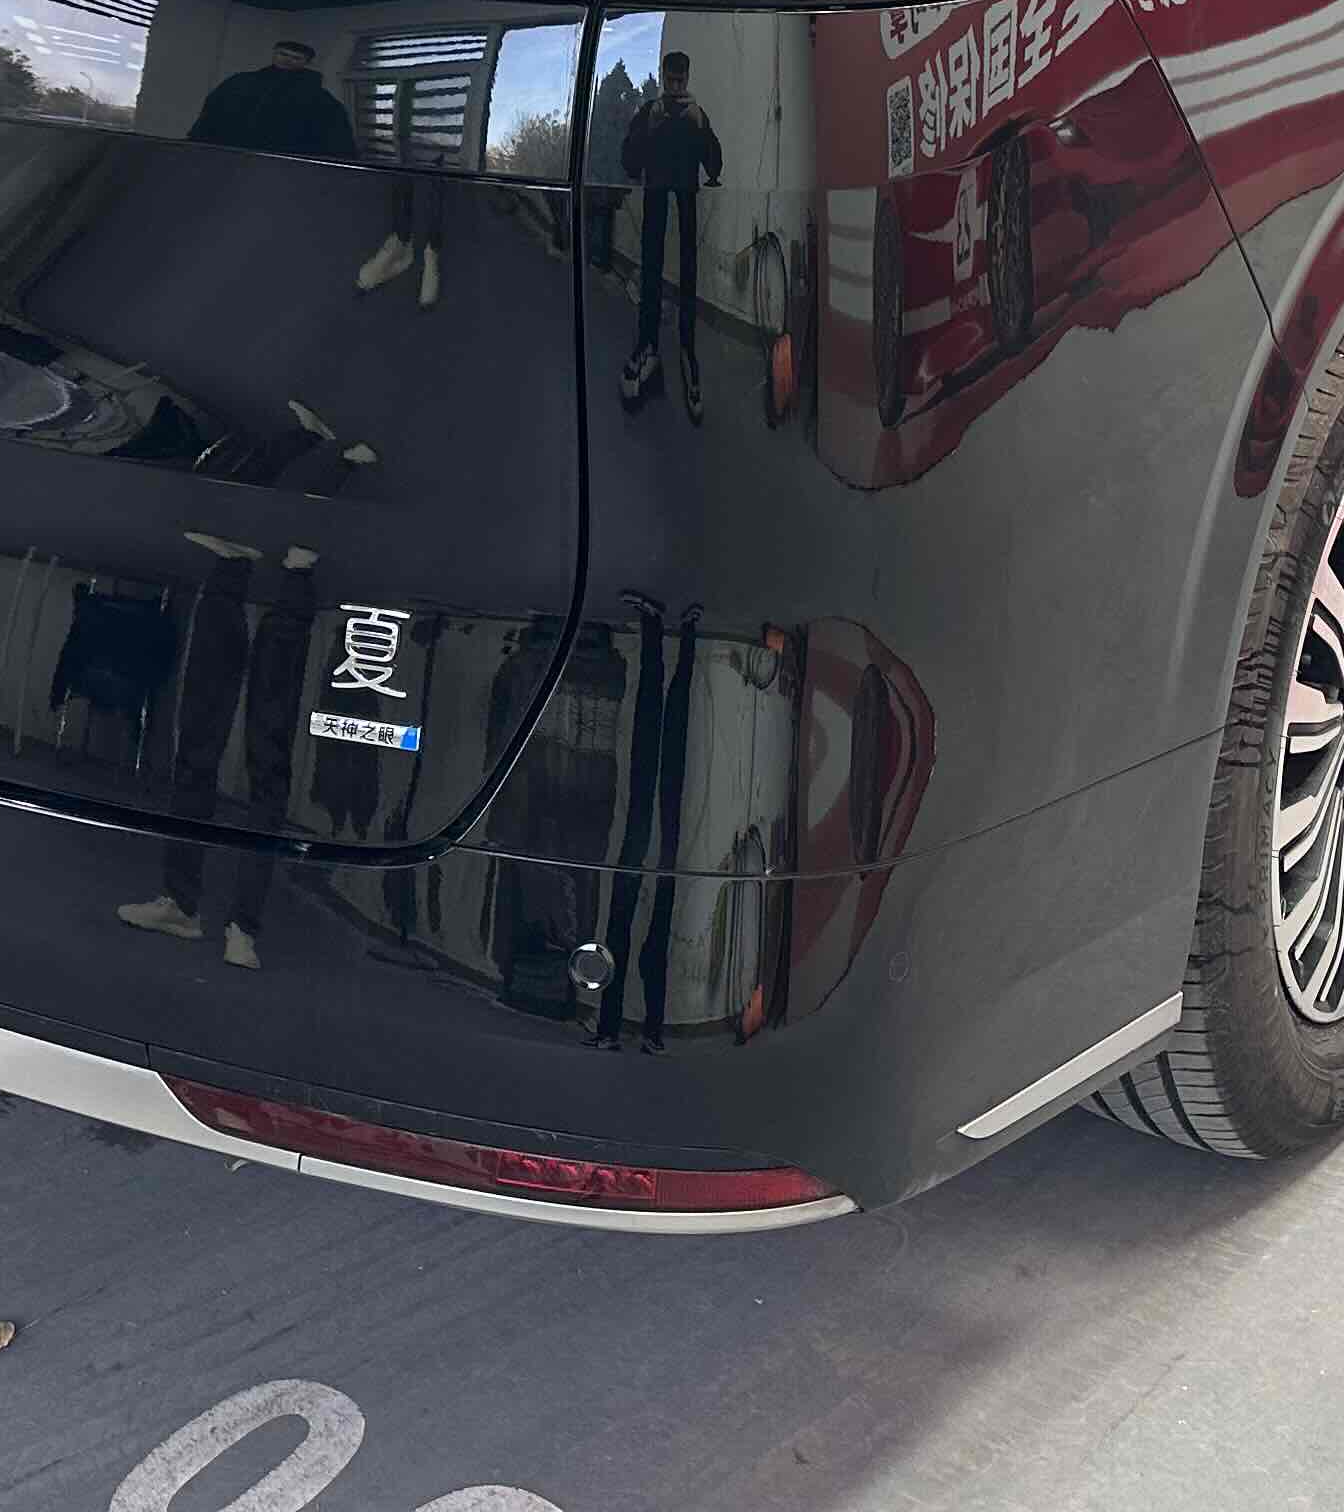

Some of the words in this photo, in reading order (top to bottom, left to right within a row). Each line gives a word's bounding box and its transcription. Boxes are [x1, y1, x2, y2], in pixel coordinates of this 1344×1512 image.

[331, 603, 412, 699] 夏
[322, 715, 396, 745] 天神之眼
